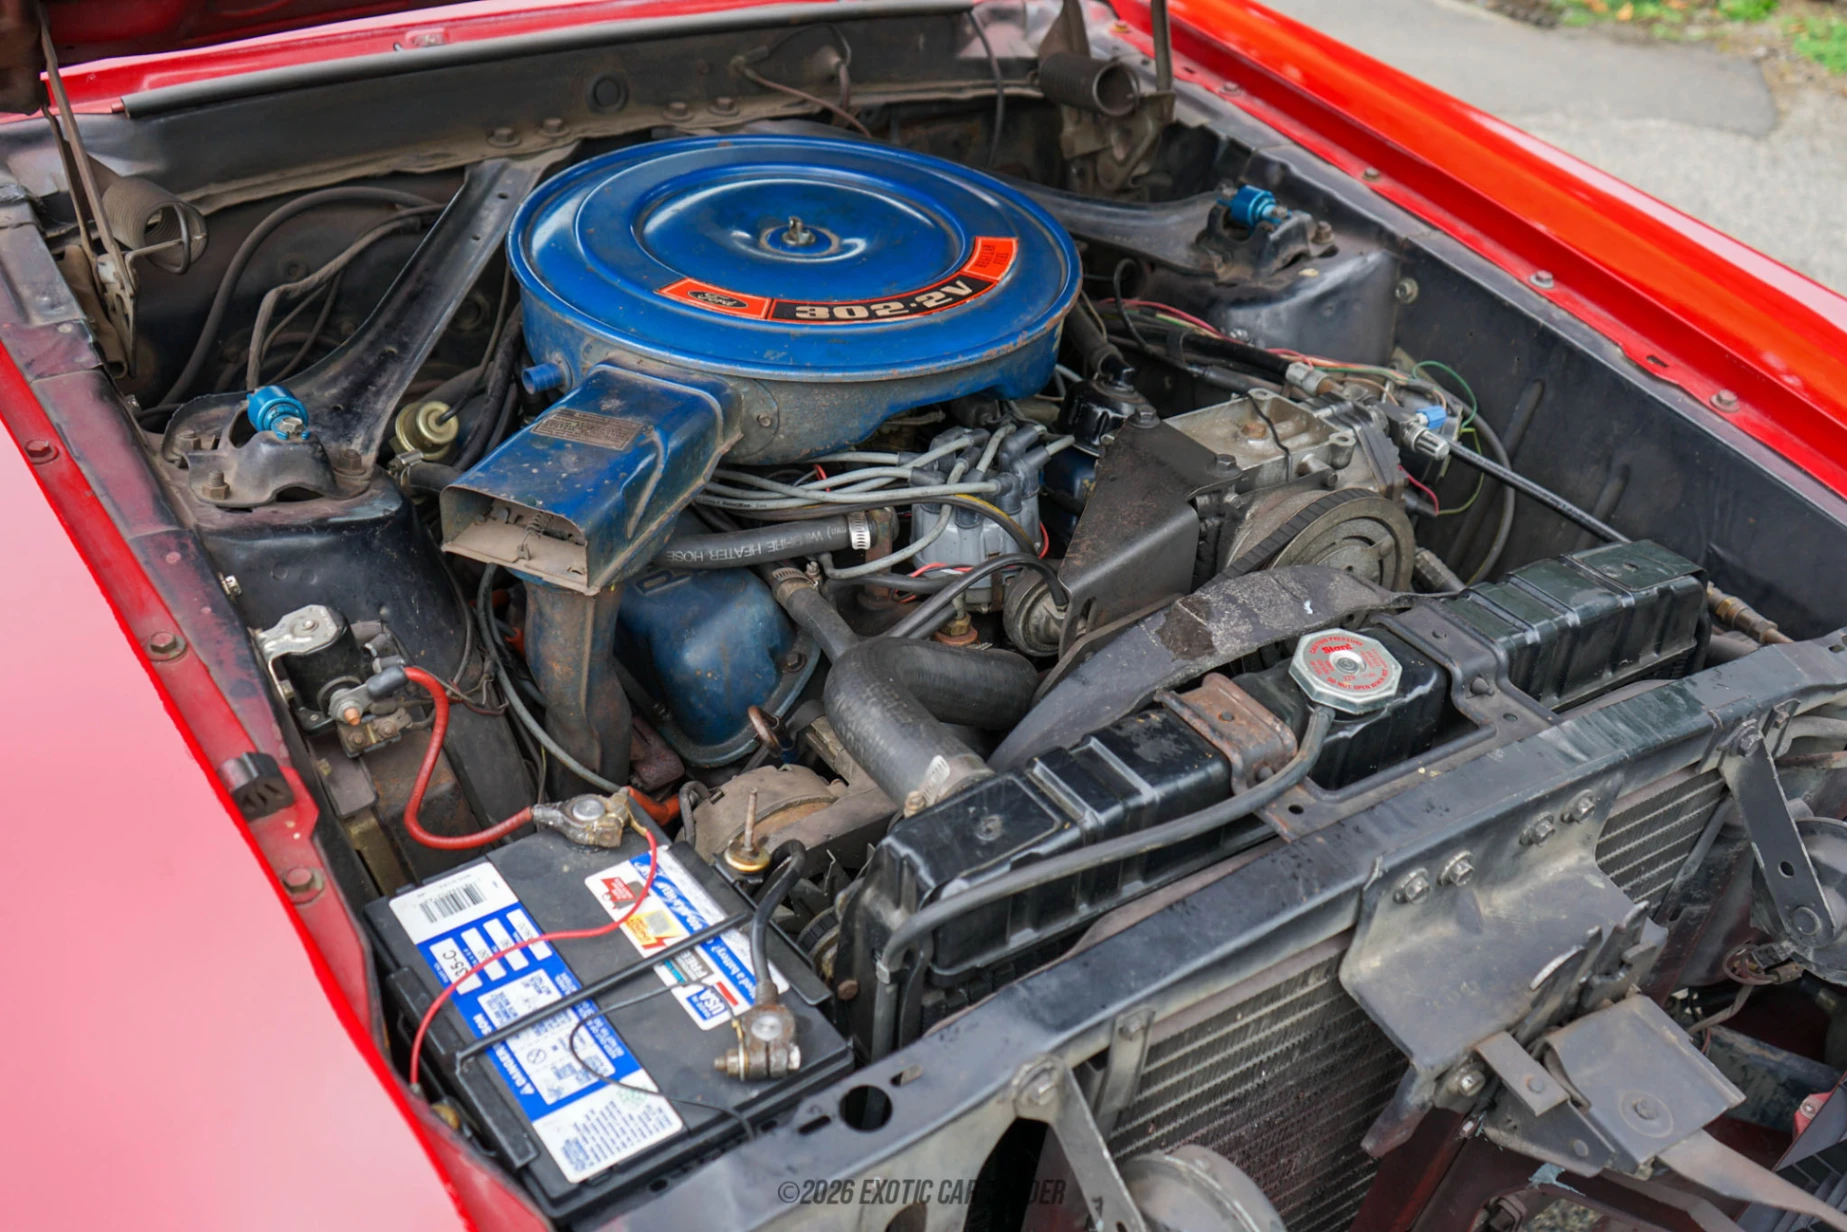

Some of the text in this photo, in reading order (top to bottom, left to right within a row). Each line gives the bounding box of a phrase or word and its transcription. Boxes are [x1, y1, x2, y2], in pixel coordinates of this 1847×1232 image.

[666, 550, 705, 563] HOSE
[710, 541, 762, 562] HEATER
[1322, 643, 1354, 654] Stant
[680, 951, 707, 977] FREE
[711, 943, 742, 974] battery?
[699, 989, 724, 1014] USA
